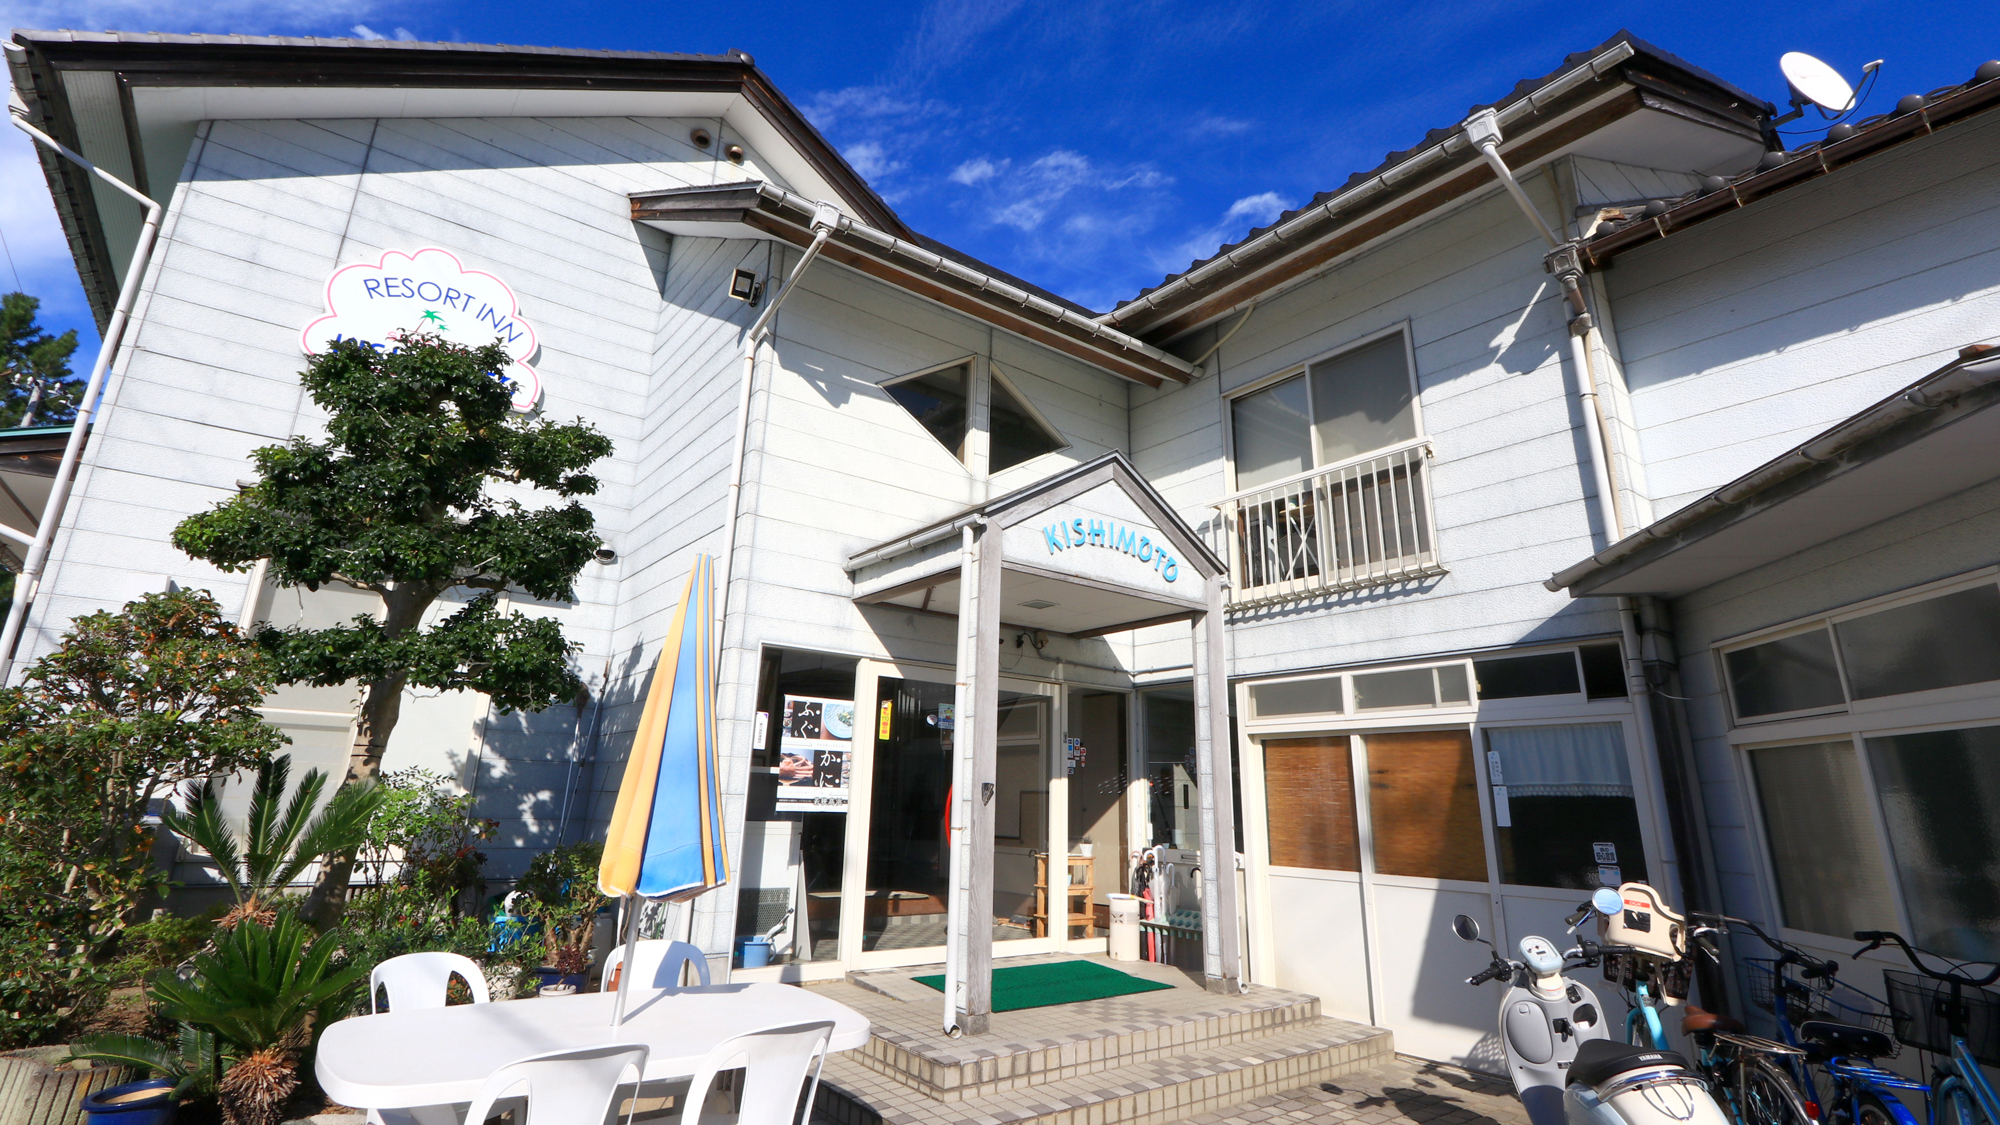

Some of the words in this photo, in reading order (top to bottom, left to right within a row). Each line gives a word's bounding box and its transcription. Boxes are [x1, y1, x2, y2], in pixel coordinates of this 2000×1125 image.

[363, 277, 476, 312] RESORT
[475, 303, 524, 343] INN
[1043, 518, 1179, 582] KISHIMOTO
[1638, 1053, 1663, 1062] YAMAHA
